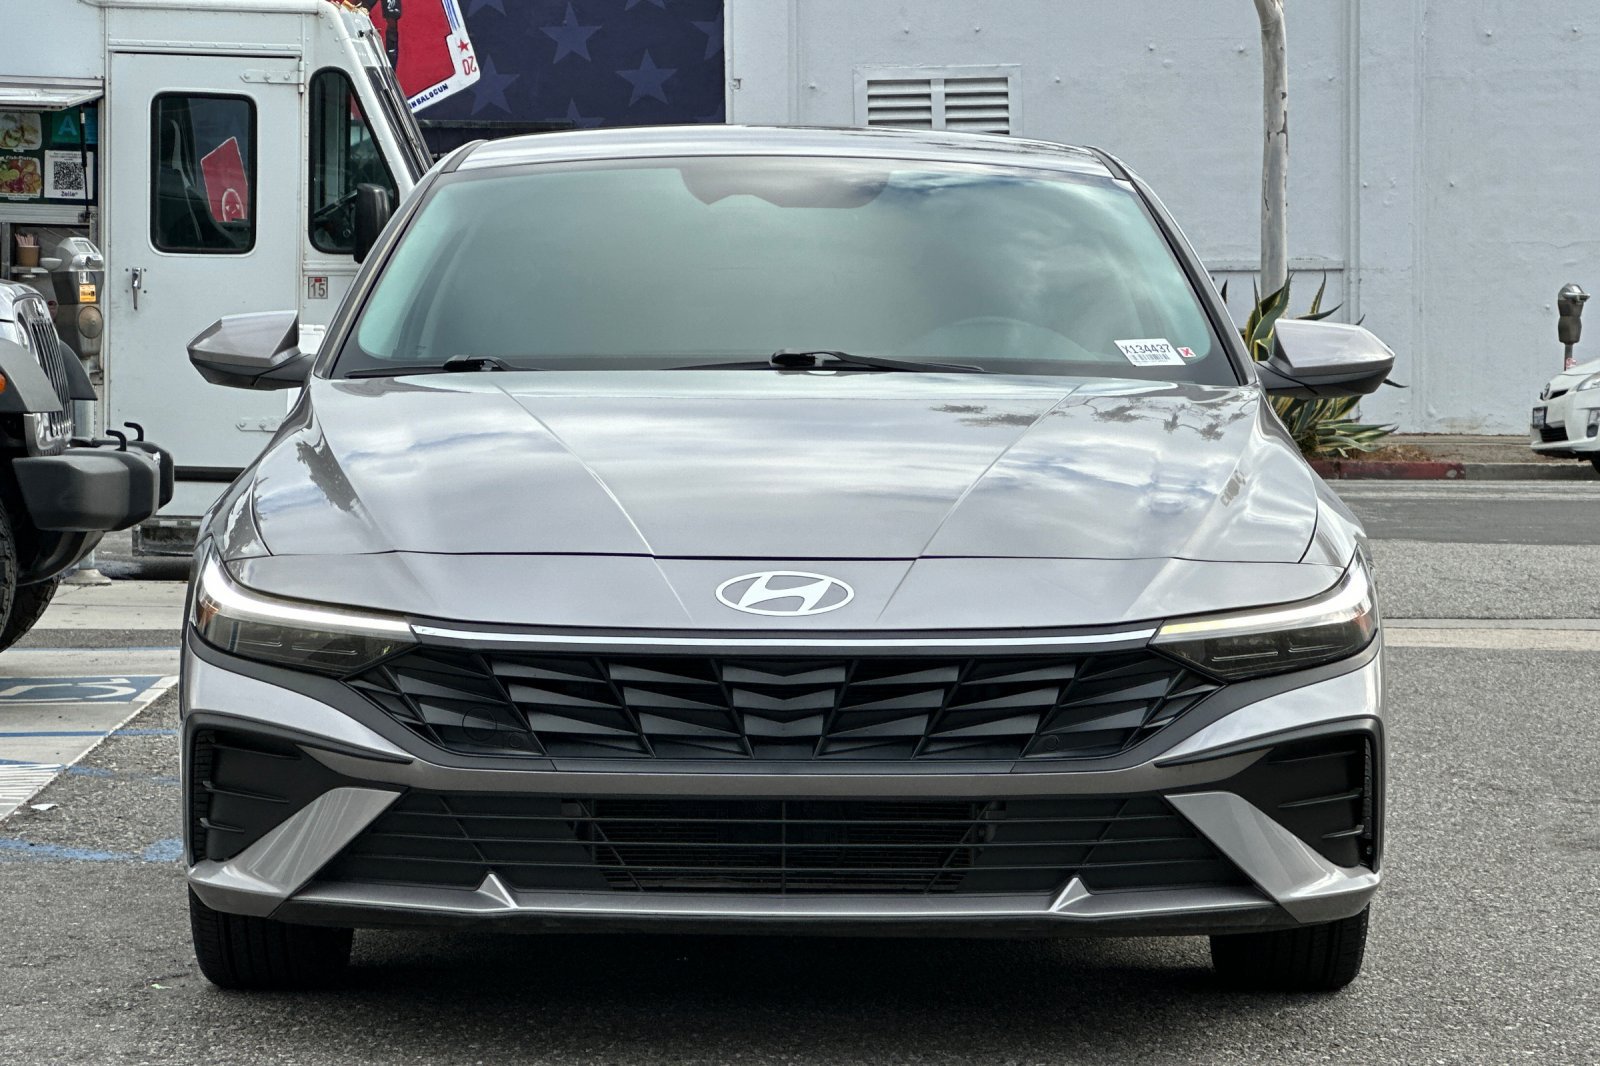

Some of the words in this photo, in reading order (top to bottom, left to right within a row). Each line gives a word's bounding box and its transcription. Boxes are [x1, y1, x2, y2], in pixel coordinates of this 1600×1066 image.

[58, 115, 78, 136] A
[310, 282, 326, 297] 15
[1121, 343, 1171, 354] X134437
